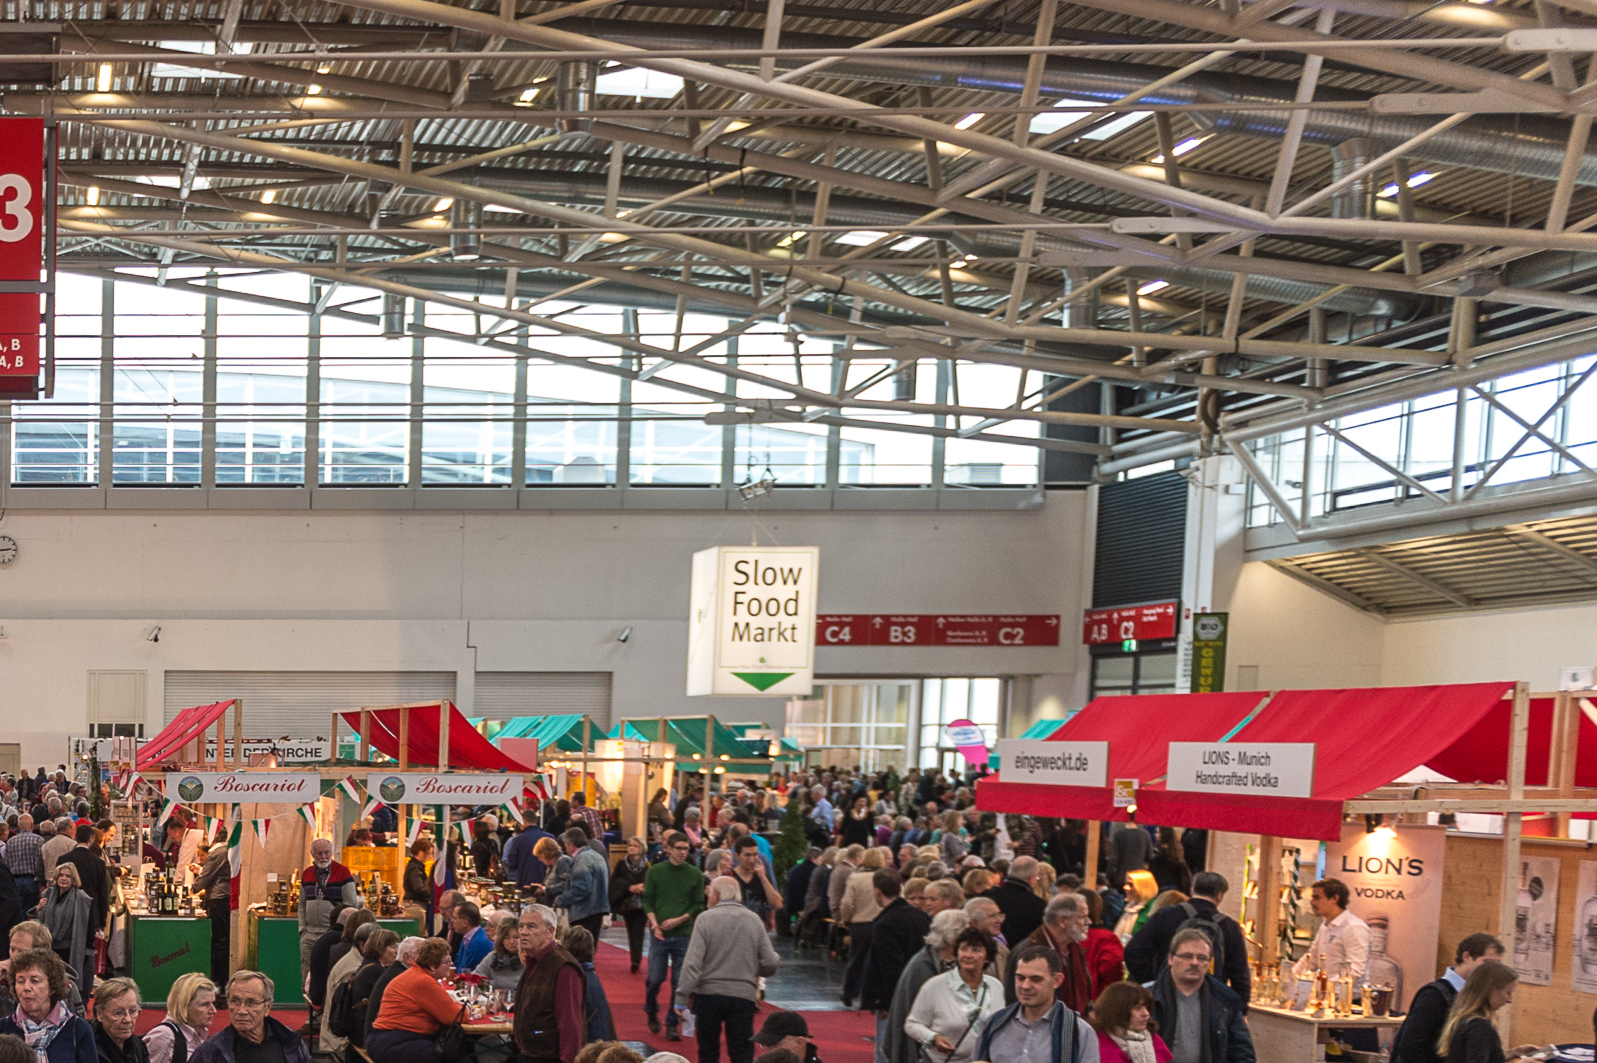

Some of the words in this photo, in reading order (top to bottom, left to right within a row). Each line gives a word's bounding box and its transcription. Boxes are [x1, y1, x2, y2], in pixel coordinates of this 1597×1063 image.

[11, 338, 21, 351] B
[15, 355, 24, 368] B
[733, 559, 803, 586] Slow
[732, 590, 799, 617] Food
[731, 621, 798, 643] Markt
[825, 626, 851, 643] C4
[889, 626, 916, 643] B3
[998, 627, 1024, 645] C2
[1120, 621, 1135, 639] C2
[1014, 752, 1089, 773] eingeweckt.de
[1203, 751, 1230, 765] LIONS
[1237, 751, 1271, 766] Munich
[1195, 770, 1248, 786] Handcrafted
[1250, 772, 1279, 788] Vodka
[1354, 887, 1406, 900] VODKA
